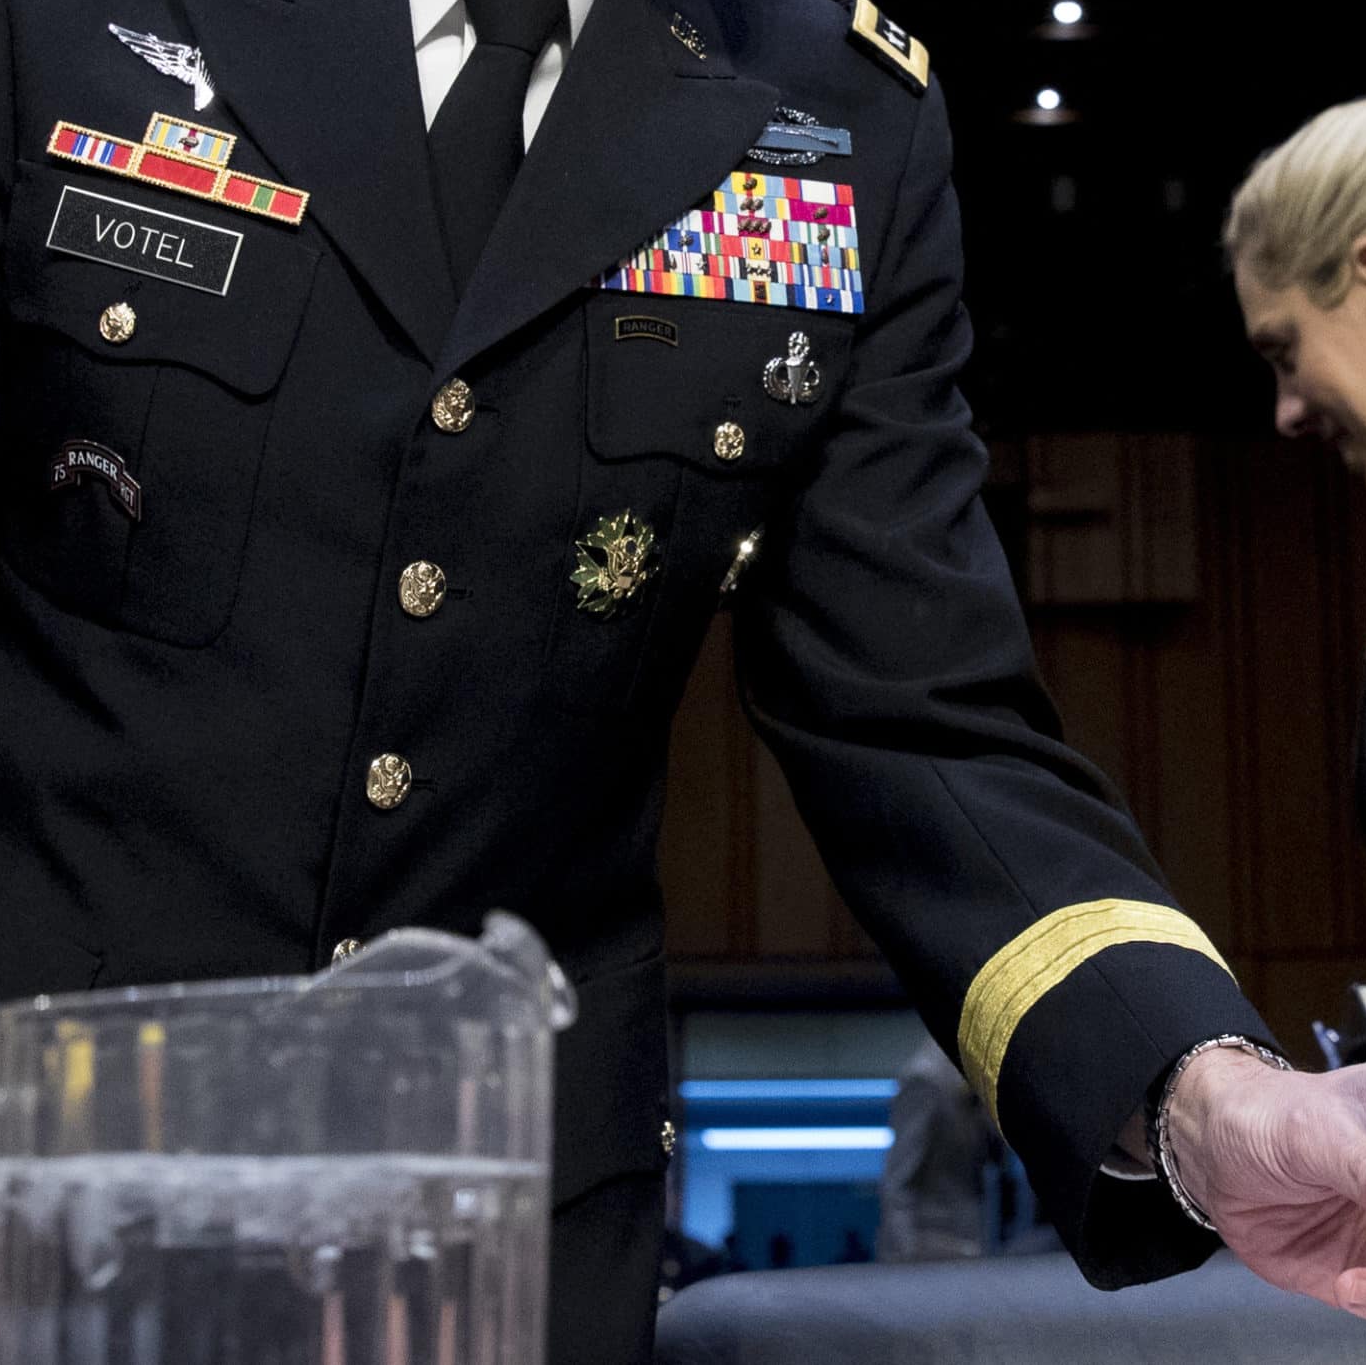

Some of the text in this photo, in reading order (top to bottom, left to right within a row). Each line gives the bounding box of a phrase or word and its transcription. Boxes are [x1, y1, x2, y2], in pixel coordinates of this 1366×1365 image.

[95, 213, 194, 269] VOTEL
[622, 321, 673, 339] RANGER
[53, 462, 67, 483] 75
[68, 450, 118, 483] RANGER
